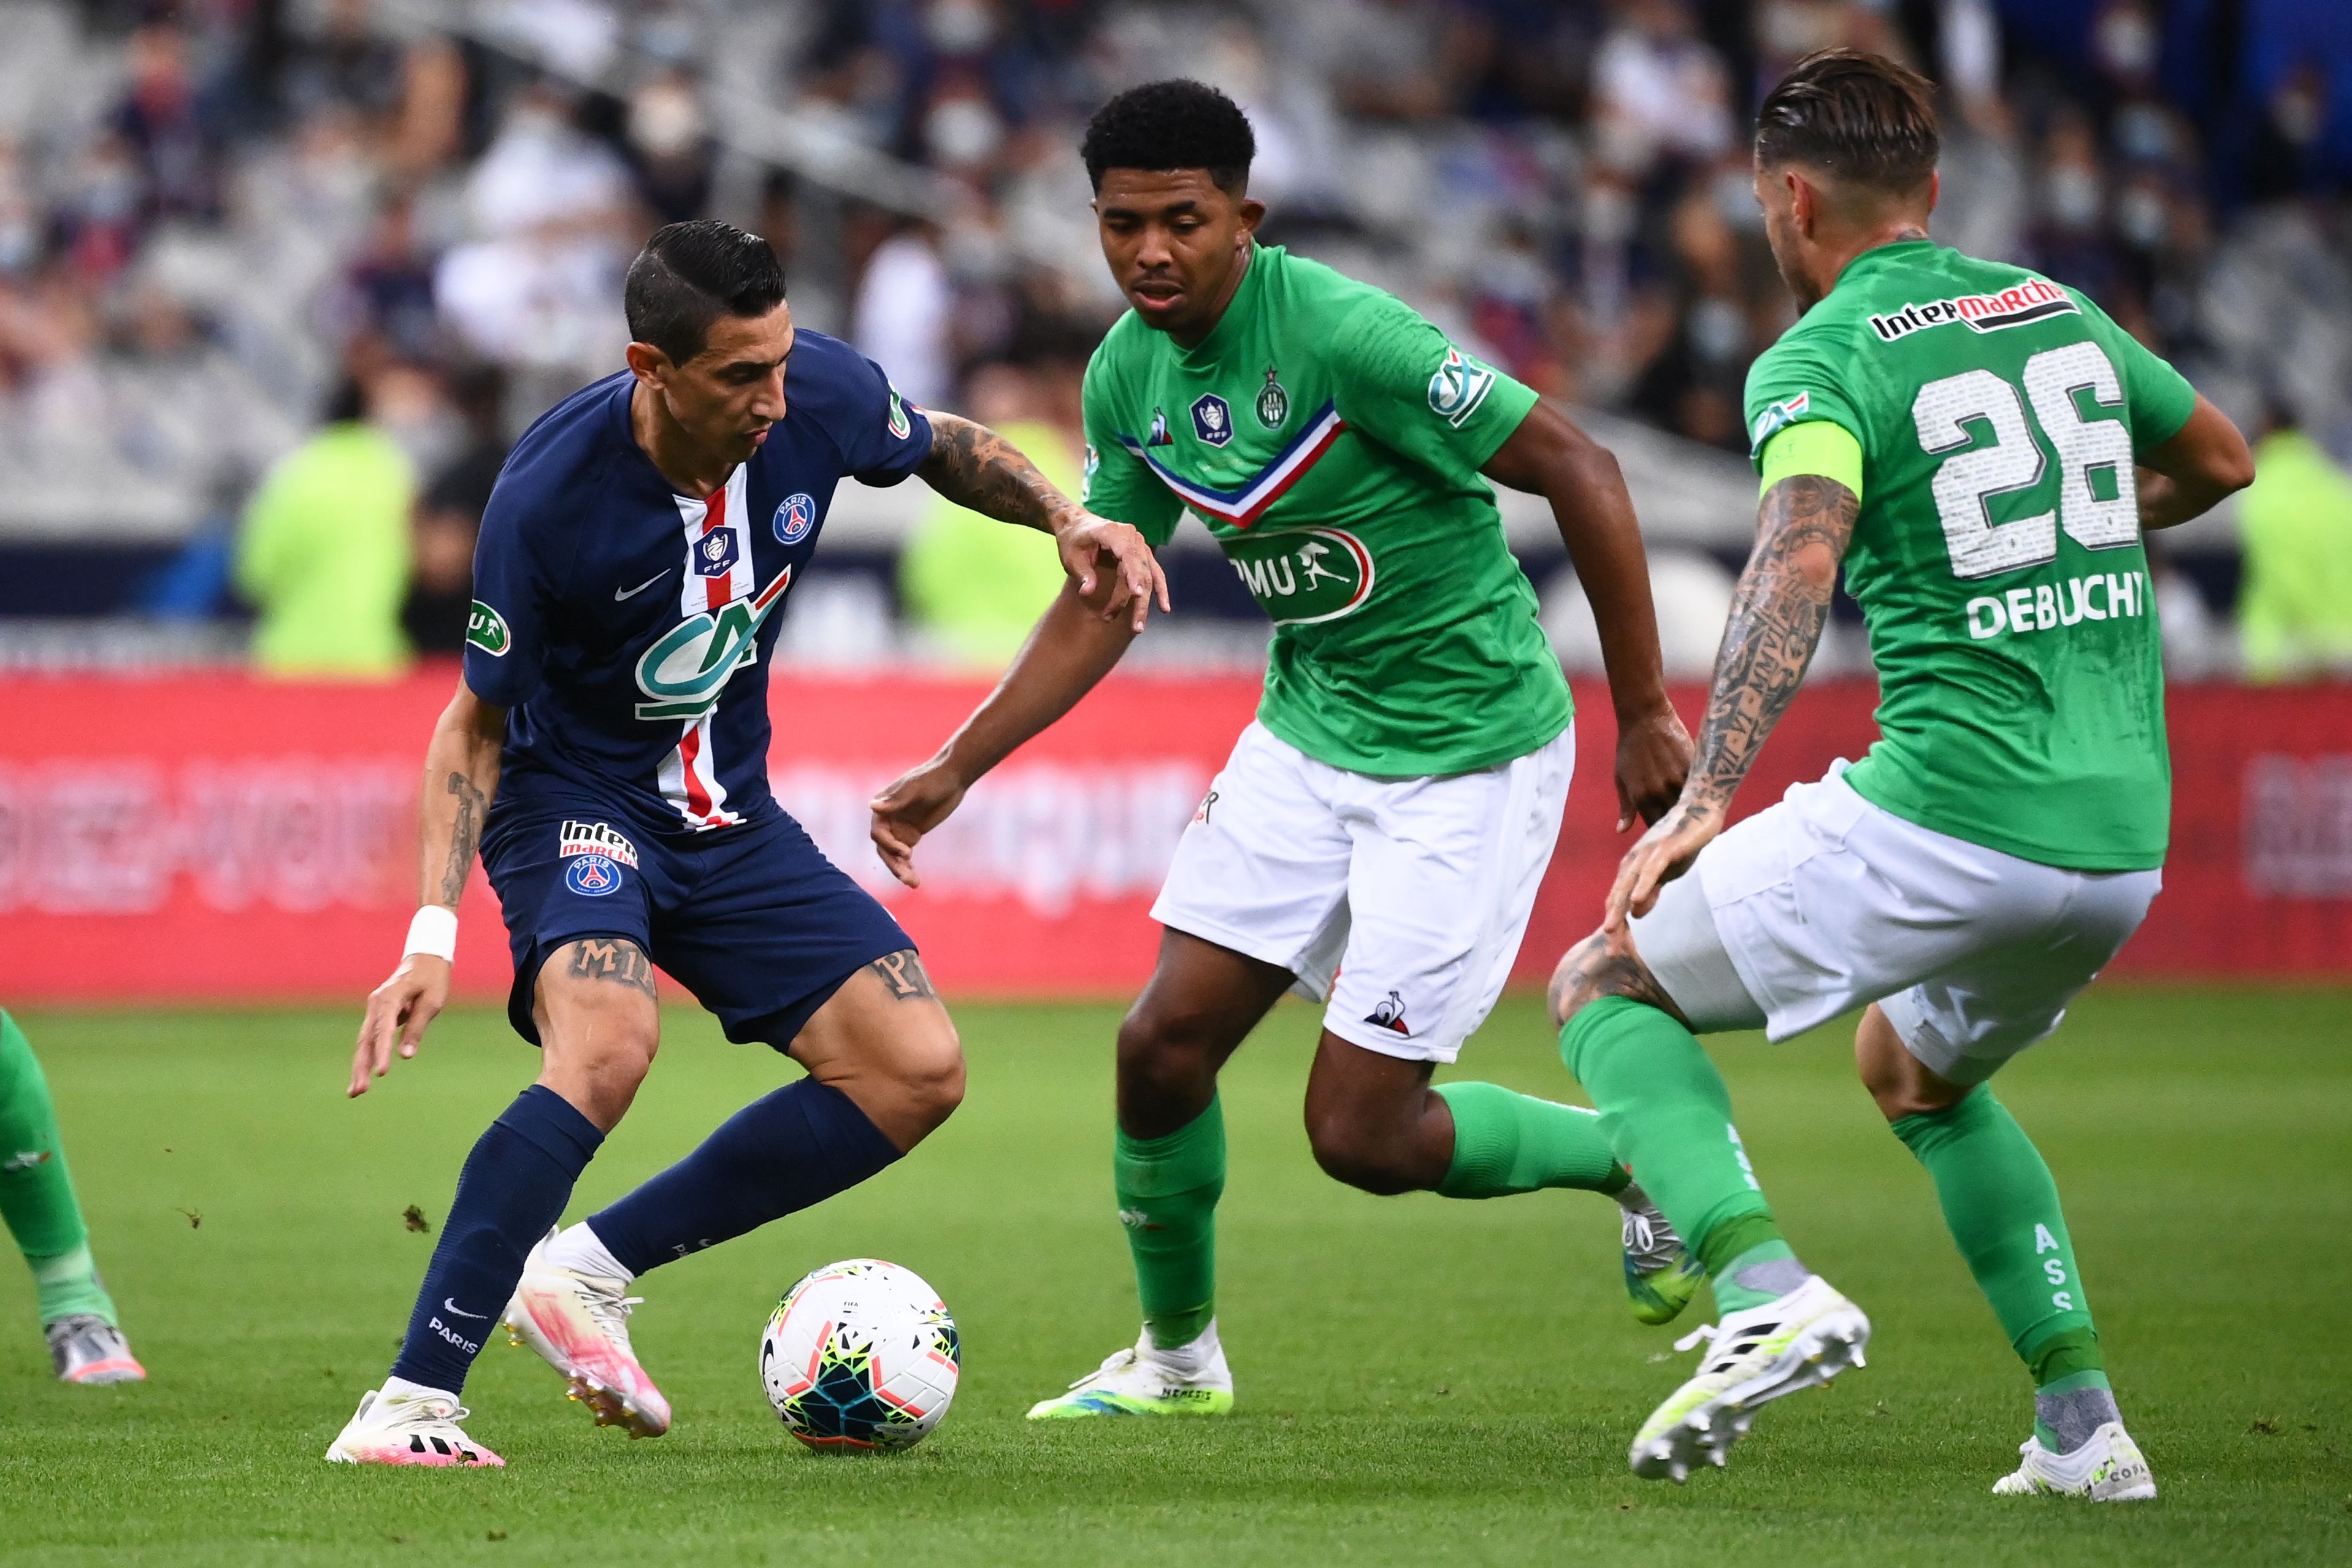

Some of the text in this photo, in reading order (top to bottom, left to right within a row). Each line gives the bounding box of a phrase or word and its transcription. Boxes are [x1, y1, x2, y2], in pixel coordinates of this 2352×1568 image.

[1911, 340, 2140, 580] 26
[779, 496, 807, 514] PARIS
[703, 559, 731, 573] FFF
[1966, 572, 2143, 639] DEBUCHY
[563, 821, 636, 858] Inter
[573, 857, 610, 870] PARIS
[429, 1316, 478, 1354] PARIS
